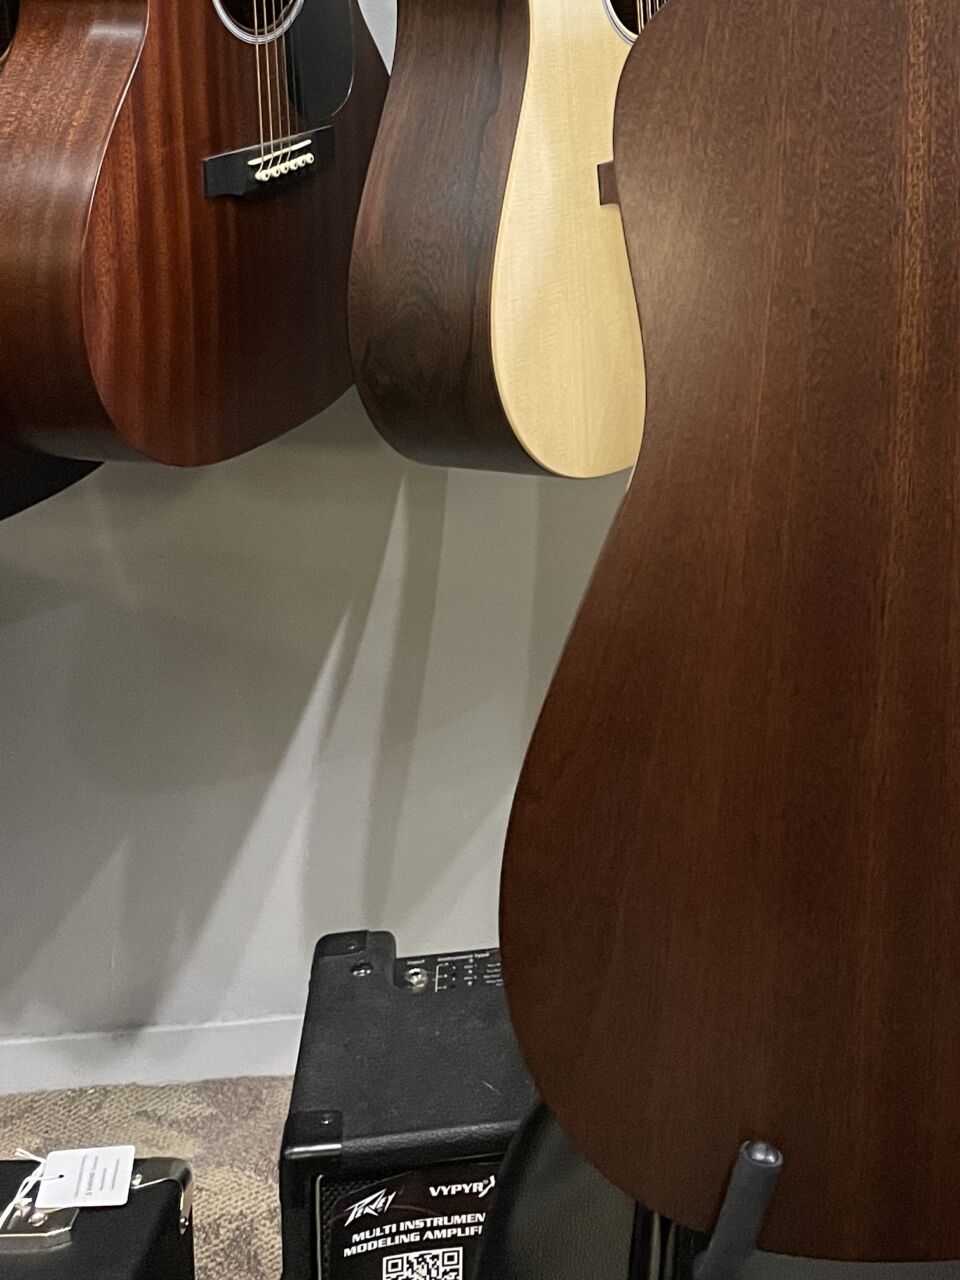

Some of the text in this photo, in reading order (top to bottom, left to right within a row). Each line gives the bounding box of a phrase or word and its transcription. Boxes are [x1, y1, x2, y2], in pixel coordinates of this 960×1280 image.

[343, 1225, 483, 1258] MODELING AMPLIFI
[352, 1212, 486, 1244] MULTI INSTRUMEN
